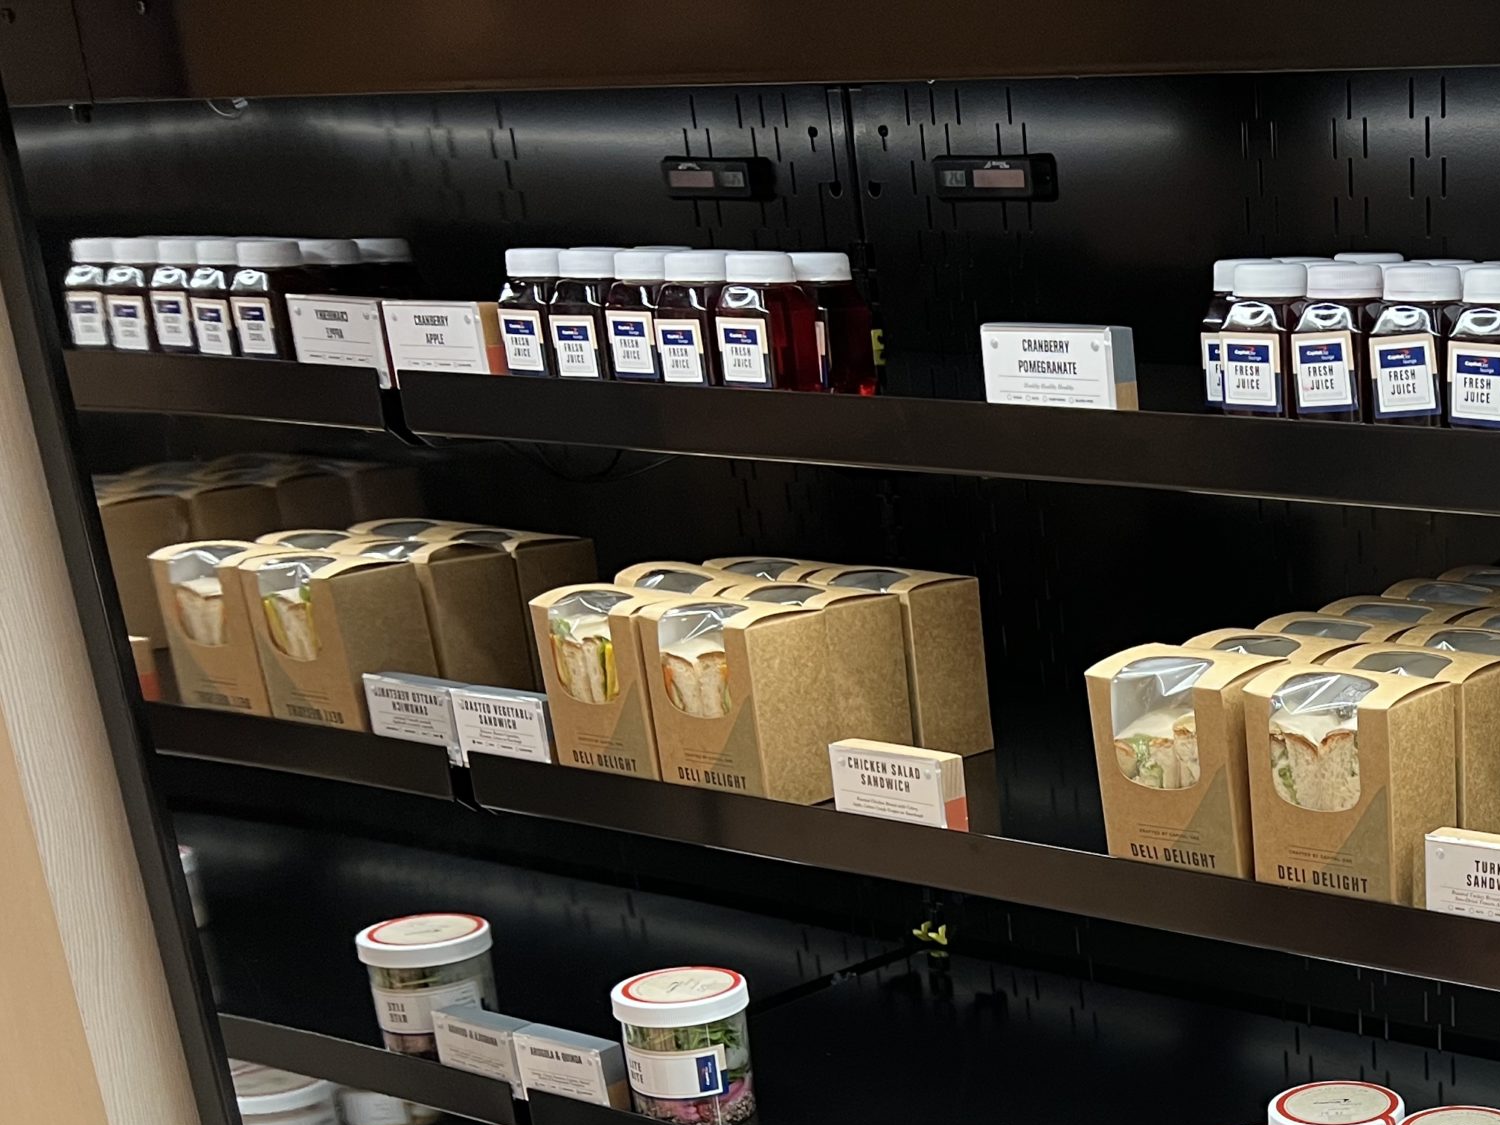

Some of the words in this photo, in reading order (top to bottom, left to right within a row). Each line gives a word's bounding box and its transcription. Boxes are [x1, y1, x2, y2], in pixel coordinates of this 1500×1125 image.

[414, 314, 449, 327] CRANBERRY
[425, 333, 445, 346] APPLE
[1022, 339, 1069, 354] CRANBERRY
[730, 346, 752, 358] FRESH
[733, 358, 752, 369] JUICE
[1018, 360, 1077, 375] POMEGRANATE
[1235, 365, 1260, 376] FRESH
[1236, 378, 1260, 390] JUICE
[1464, 377, 1492, 390] FRESH
[1464, 391, 1490, 404] JUICE
[478, 714, 518, 730] SANDWICH
[572, 750, 594, 766] DELI
[598, 754, 638, 772] DELIGHT
[848, 757, 888, 774] CHICKEN
[891, 764, 921, 780] SALAD
[678, 766, 700, 783] DELI
[704, 770, 747, 790] DELIGHT
[860, 774, 911, 793] SANDWICH
[1130, 842, 1159, 860] DELI
[1164, 847, 1216, 870] DELIGHT
[1278, 864, 1306, 884] DELI
[1312, 870, 1368, 894] DELIGHT
